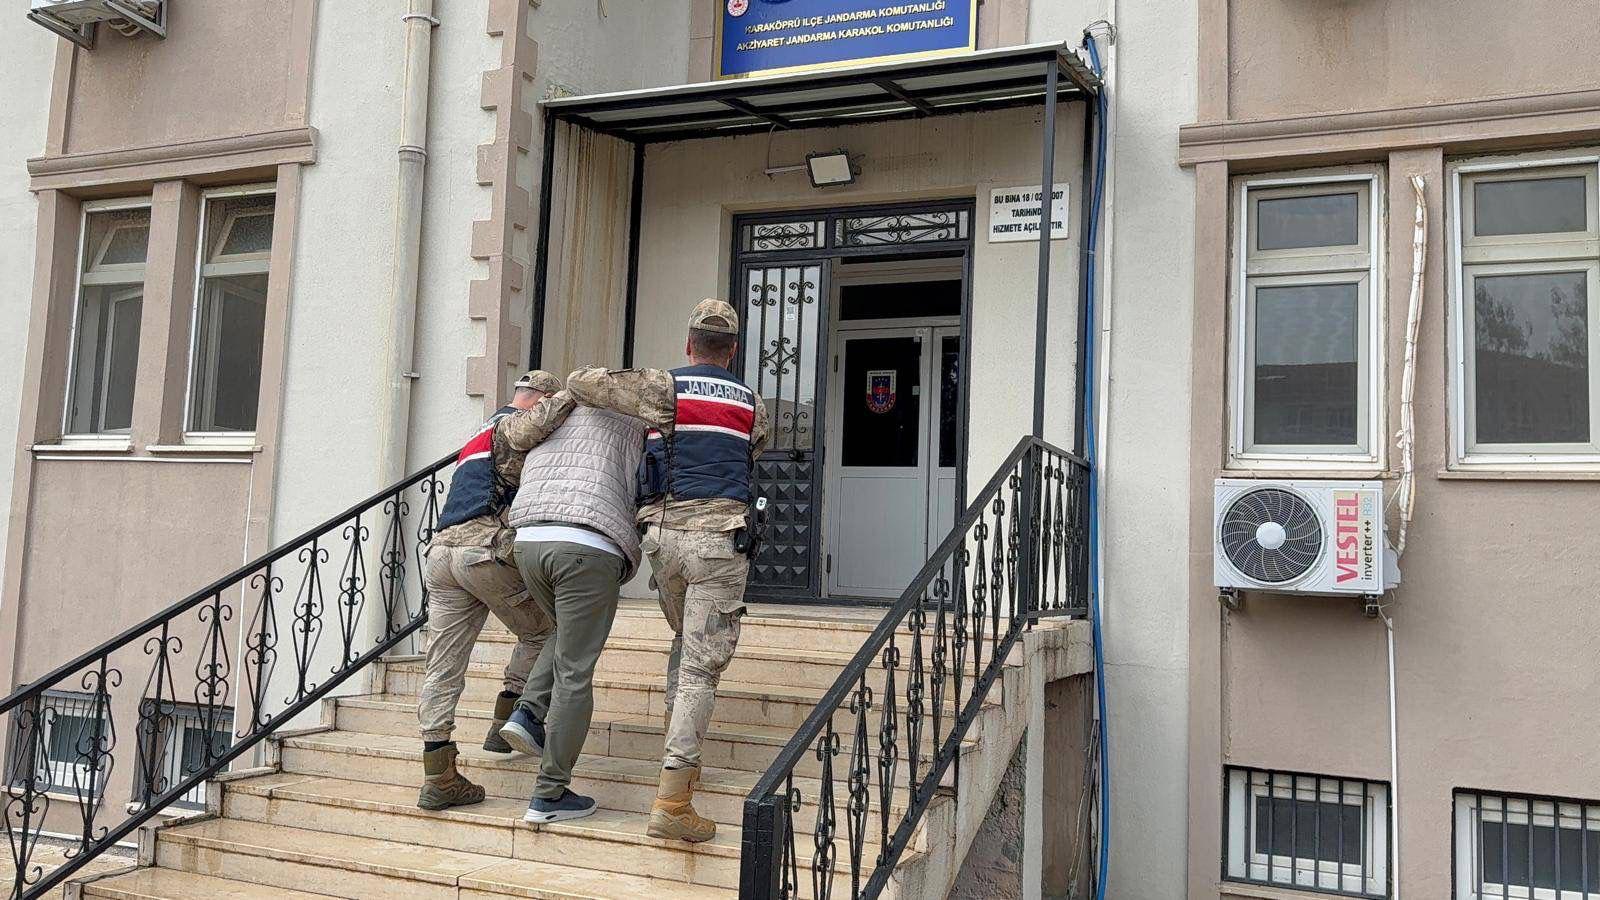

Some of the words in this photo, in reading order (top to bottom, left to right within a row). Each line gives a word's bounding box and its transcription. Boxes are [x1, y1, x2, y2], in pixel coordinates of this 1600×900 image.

[736, 36, 785, 52] AKZİYARET
[786, 31, 837, 45] JANDARMA
[839, 25, 885, 39] KARAKOL
[887, 16, 954, 33] KOMUTANLIĞI
[744, 17, 801, 34] KARAKÖPRÜ
[825, 9, 877, 24] JANDARMA
[879, 0, 946, 17] KOMUTANLIĞI
[994, 195, 1004, 204] BU
[1022, 193, 1030, 202] 18
[1051, 191, 1064, 200] 007
[684, 379, 749, 404] JANDARMA
[1336, 493, 1358, 583] VESTEL
